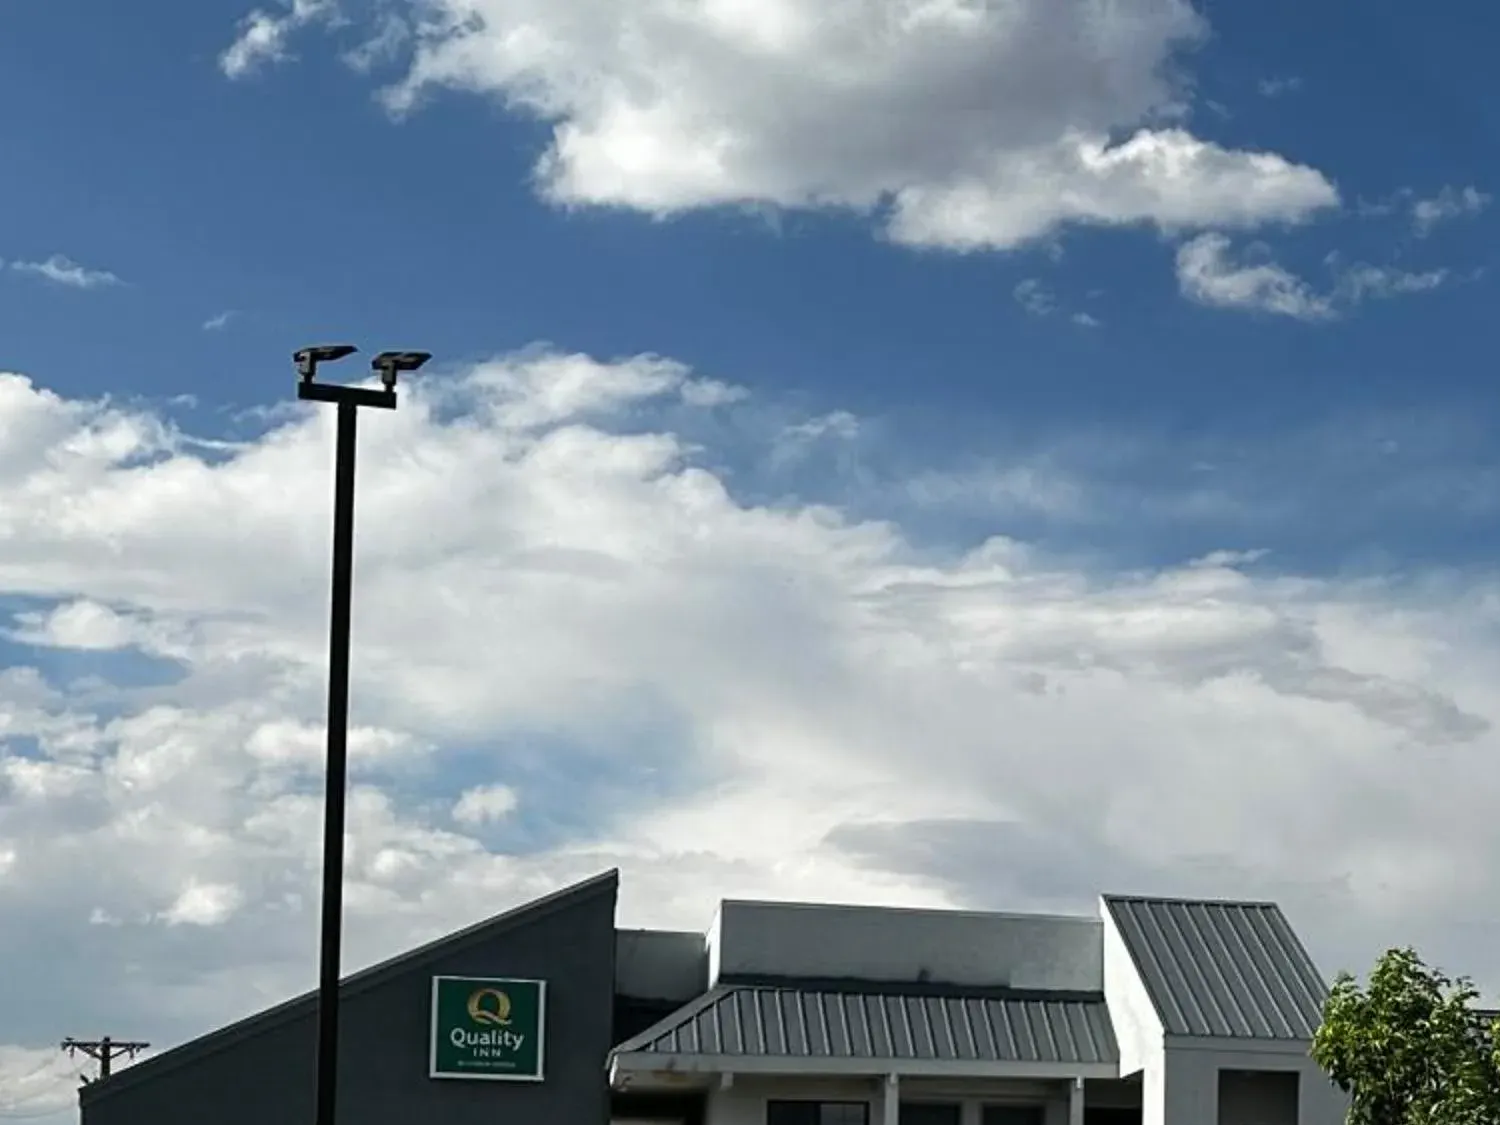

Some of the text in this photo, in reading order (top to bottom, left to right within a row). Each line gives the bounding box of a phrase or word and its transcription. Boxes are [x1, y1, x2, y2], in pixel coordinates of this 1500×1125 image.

[467, 988, 512, 1025] Q
[450, 1027, 525, 1051] Quality
[473, 1047, 502, 1057] INN
